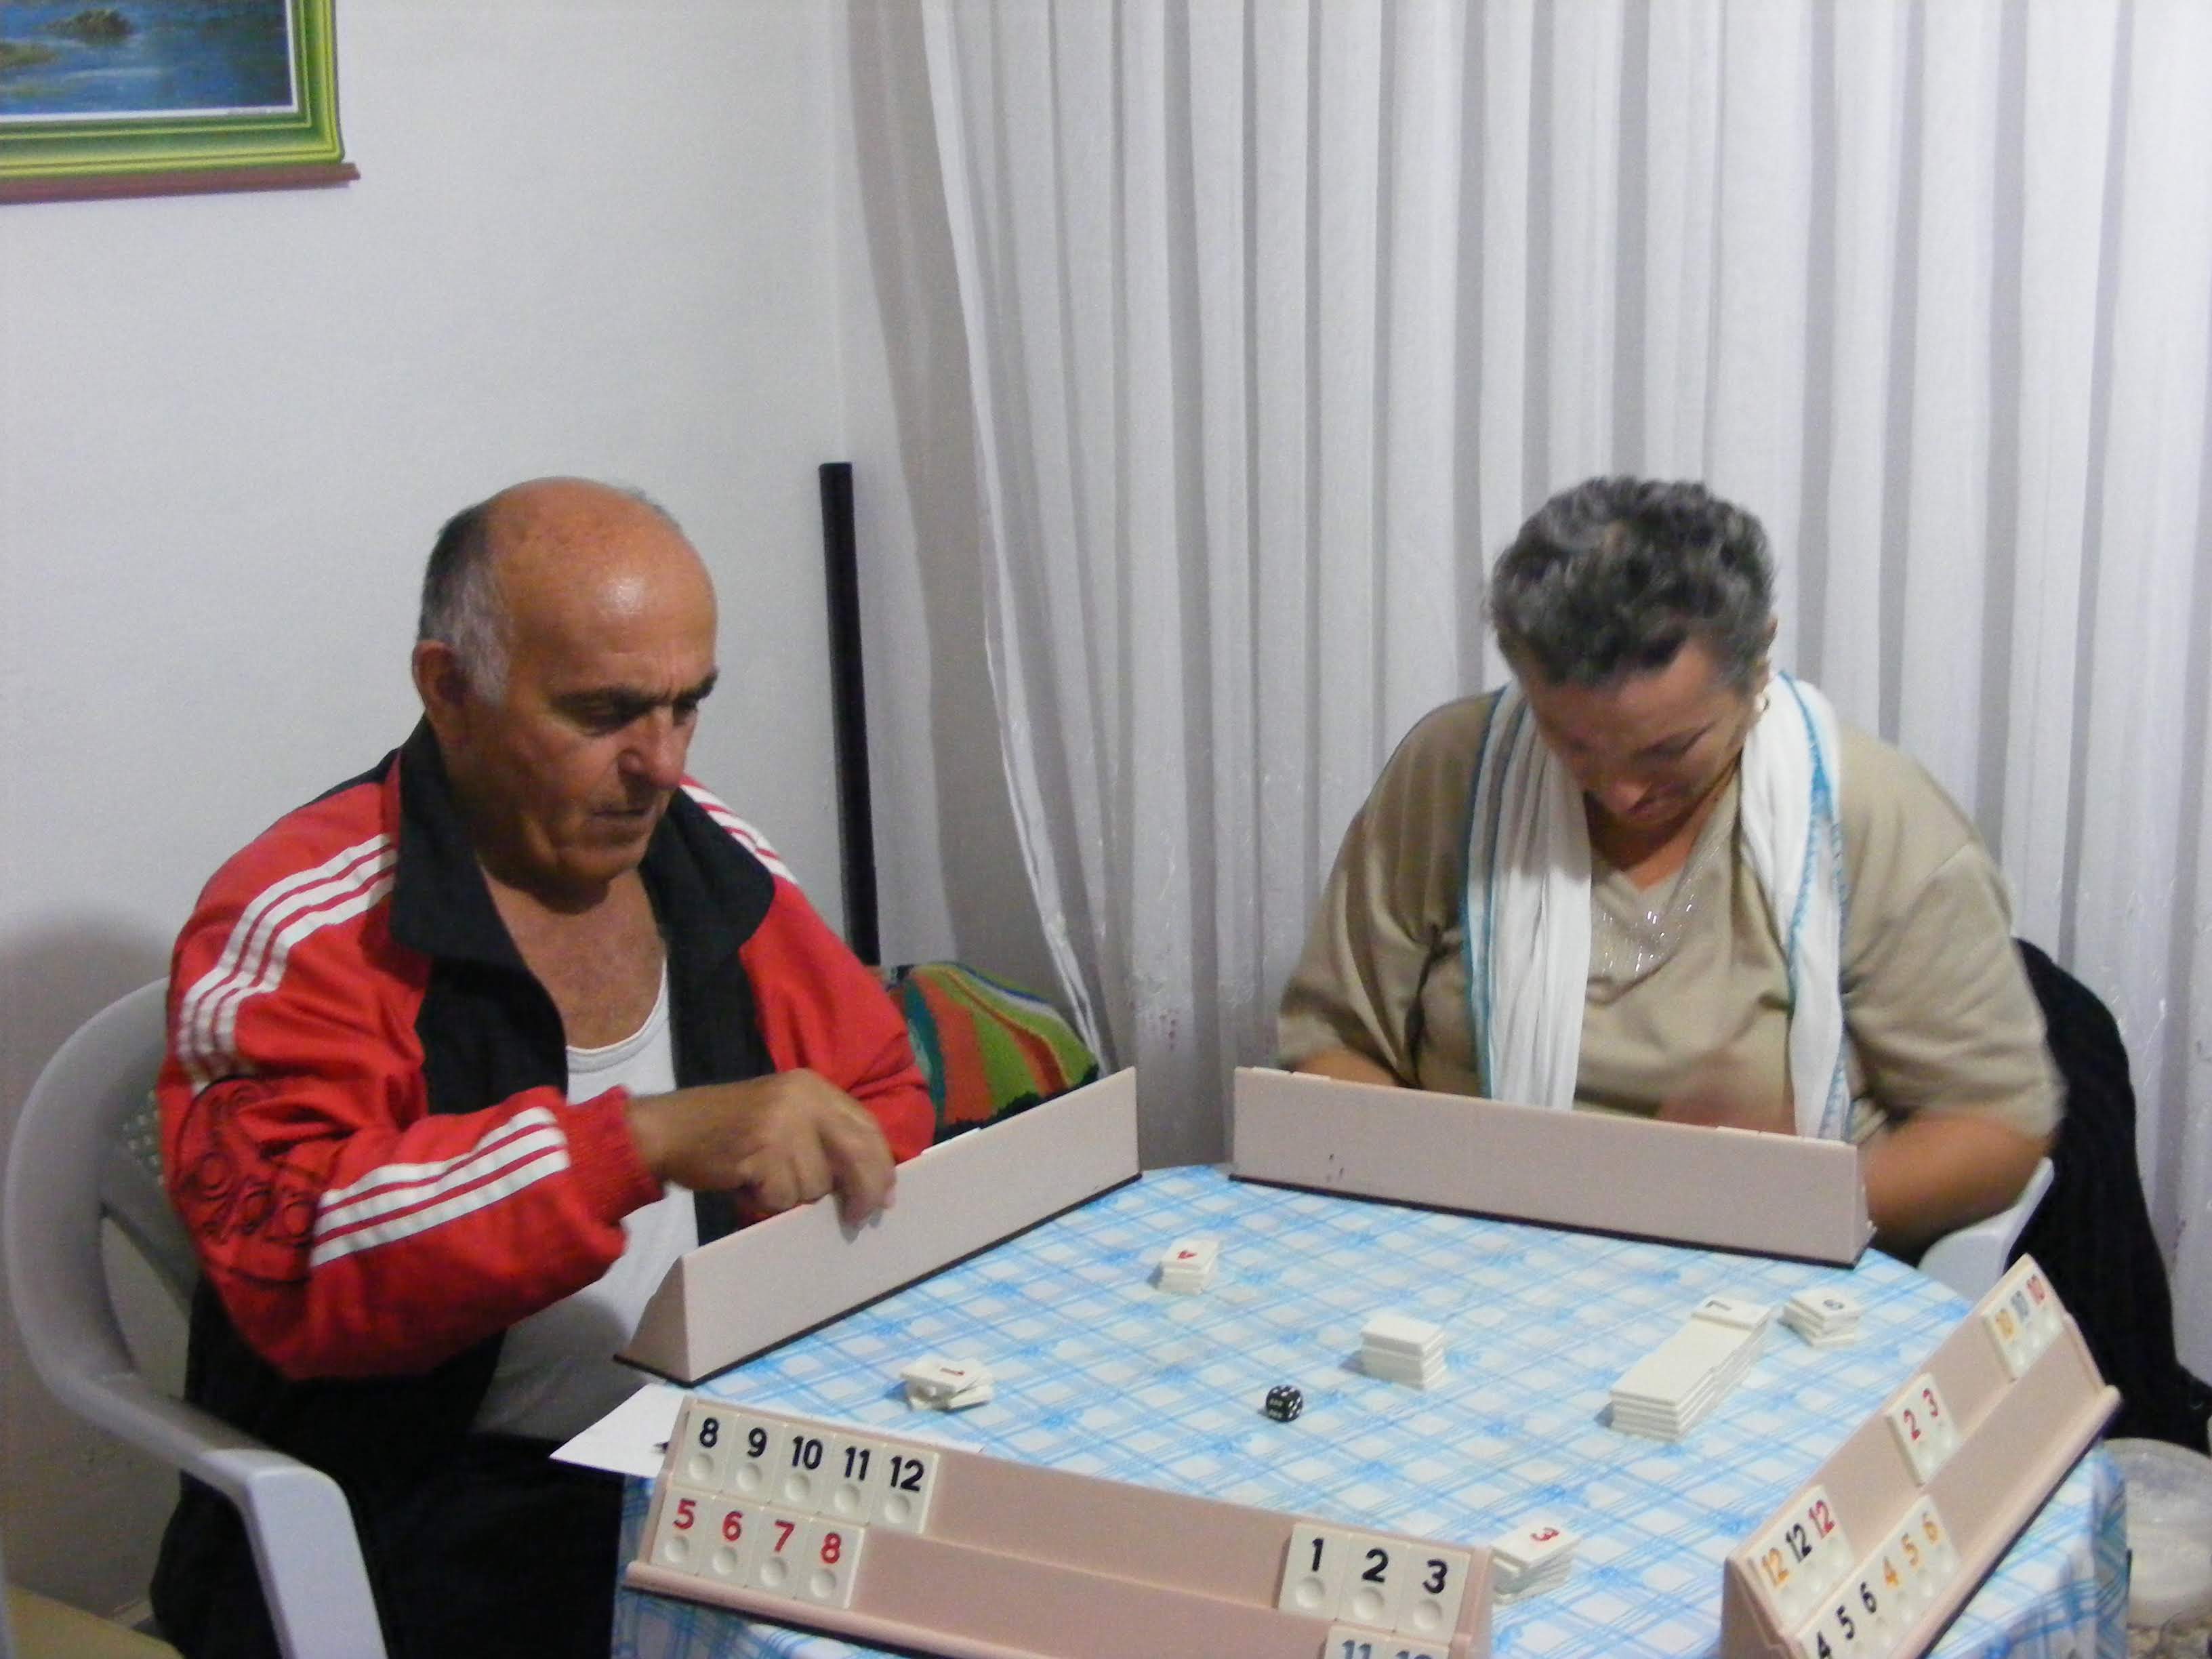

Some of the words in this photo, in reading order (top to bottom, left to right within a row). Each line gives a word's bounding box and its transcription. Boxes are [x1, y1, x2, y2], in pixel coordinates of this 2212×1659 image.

[1903, 1409, 1921, 1441] 2
[1922, 1388, 1939, 1417] 3
[699, 1417, 720, 1448] 8
[747, 1427, 768, 1458] 9
[792, 1435, 823, 1470] 10
[844, 1446, 870, 1481] 11
[890, 1456, 924, 1492] 12
[673, 1498, 696, 1530] 5
[722, 1511, 743, 1541] 6
[775, 1520, 795, 1552] 7
[821, 1532, 842, 1564] 8
[1311, 1538, 1324, 1572] 1
[1362, 1549, 1389, 1583] 2
[1422, 1559, 1448, 1594] 3
[1762, 1547, 1789, 1587] 12
[1785, 1523, 1812, 1564] 12
[1808, 1500, 1836, 1540] 12
[1816, 1629, 1833, 1659] 4
[1837, 1605, 1855, 1640] 5
[1860, 1581, 1877, 1614] 6
[1883, 1556, 1900, 1586] 4
[1901, 1533, 1919, 1568] 5
